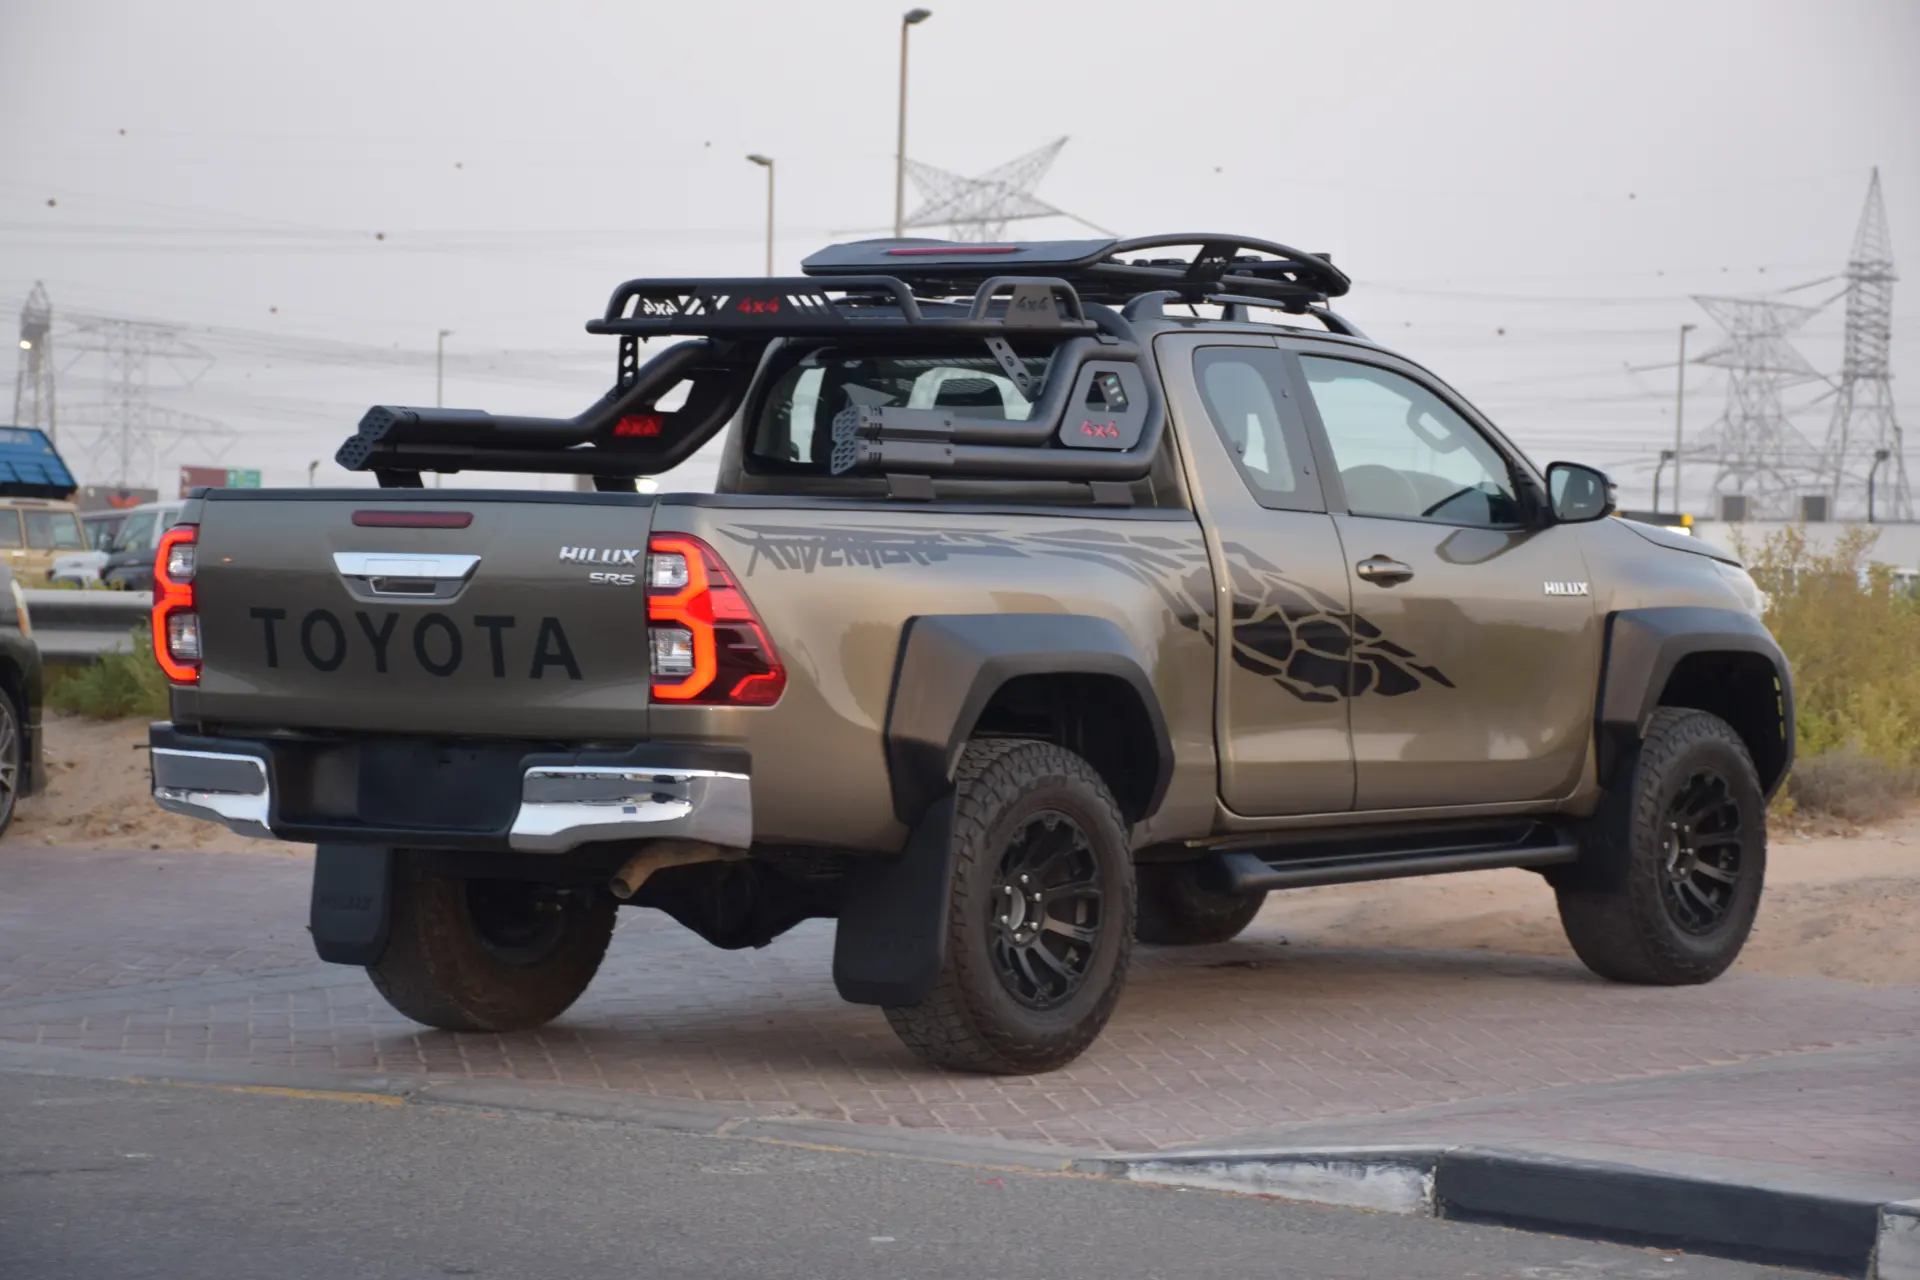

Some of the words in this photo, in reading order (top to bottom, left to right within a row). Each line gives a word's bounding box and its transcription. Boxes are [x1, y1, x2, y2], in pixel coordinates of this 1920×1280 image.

[736, 296, 780, 314] 4x4
[1015, 296, 1049, 312] 4x4
[1080, 419, 1120, 439] 4x4
[559, 546, 640, 566] HILUX
[1543, 581, 1589, 597] HILUX
[250, 607, 582, 681] TOYOTA
